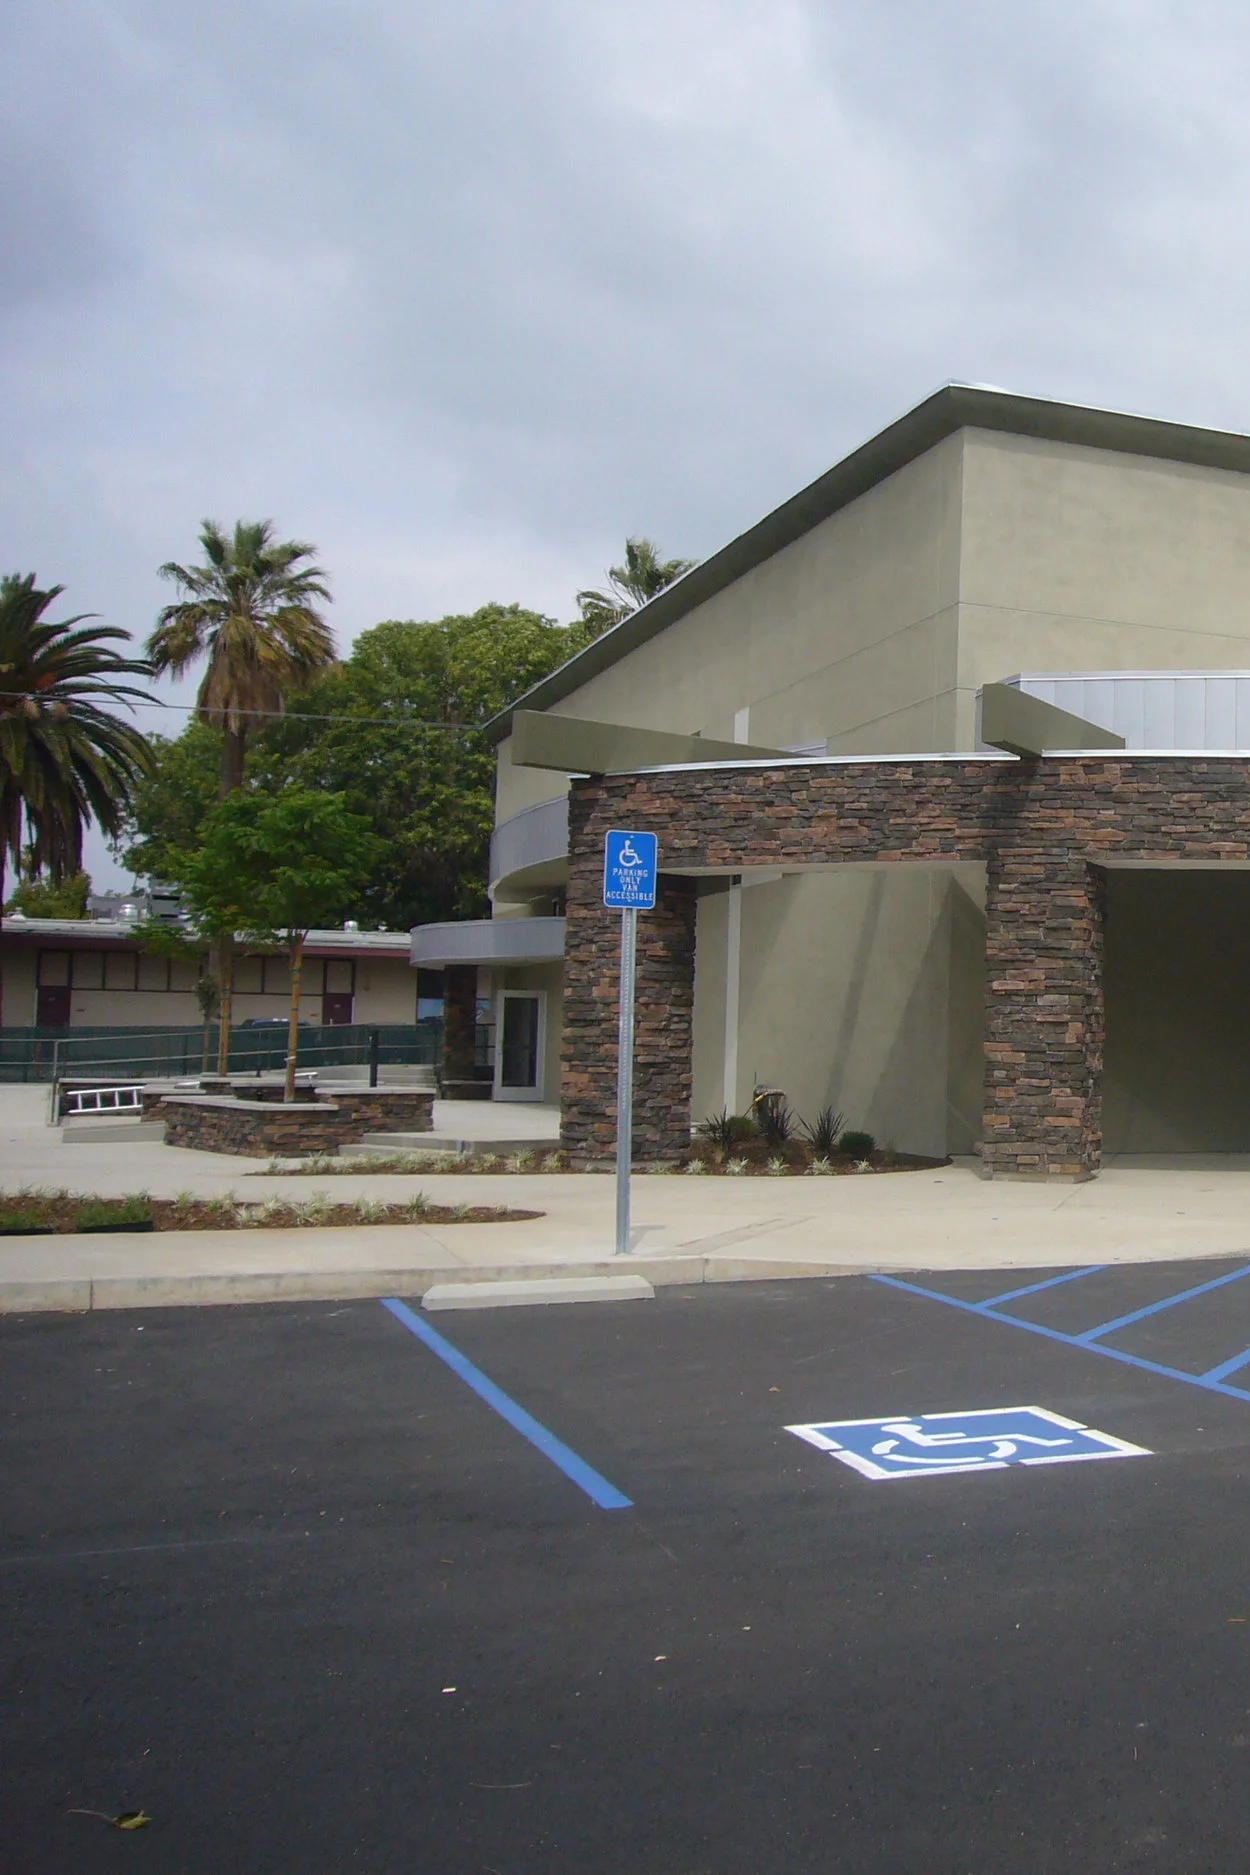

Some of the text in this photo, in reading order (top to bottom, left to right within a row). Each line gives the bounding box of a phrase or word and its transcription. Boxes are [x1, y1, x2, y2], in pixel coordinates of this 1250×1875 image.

[612, 868, 648, 877] PARKING
[620, 876, 641, 884] ONLY
[606, 891, 654, 900] ACCESSIBLE
